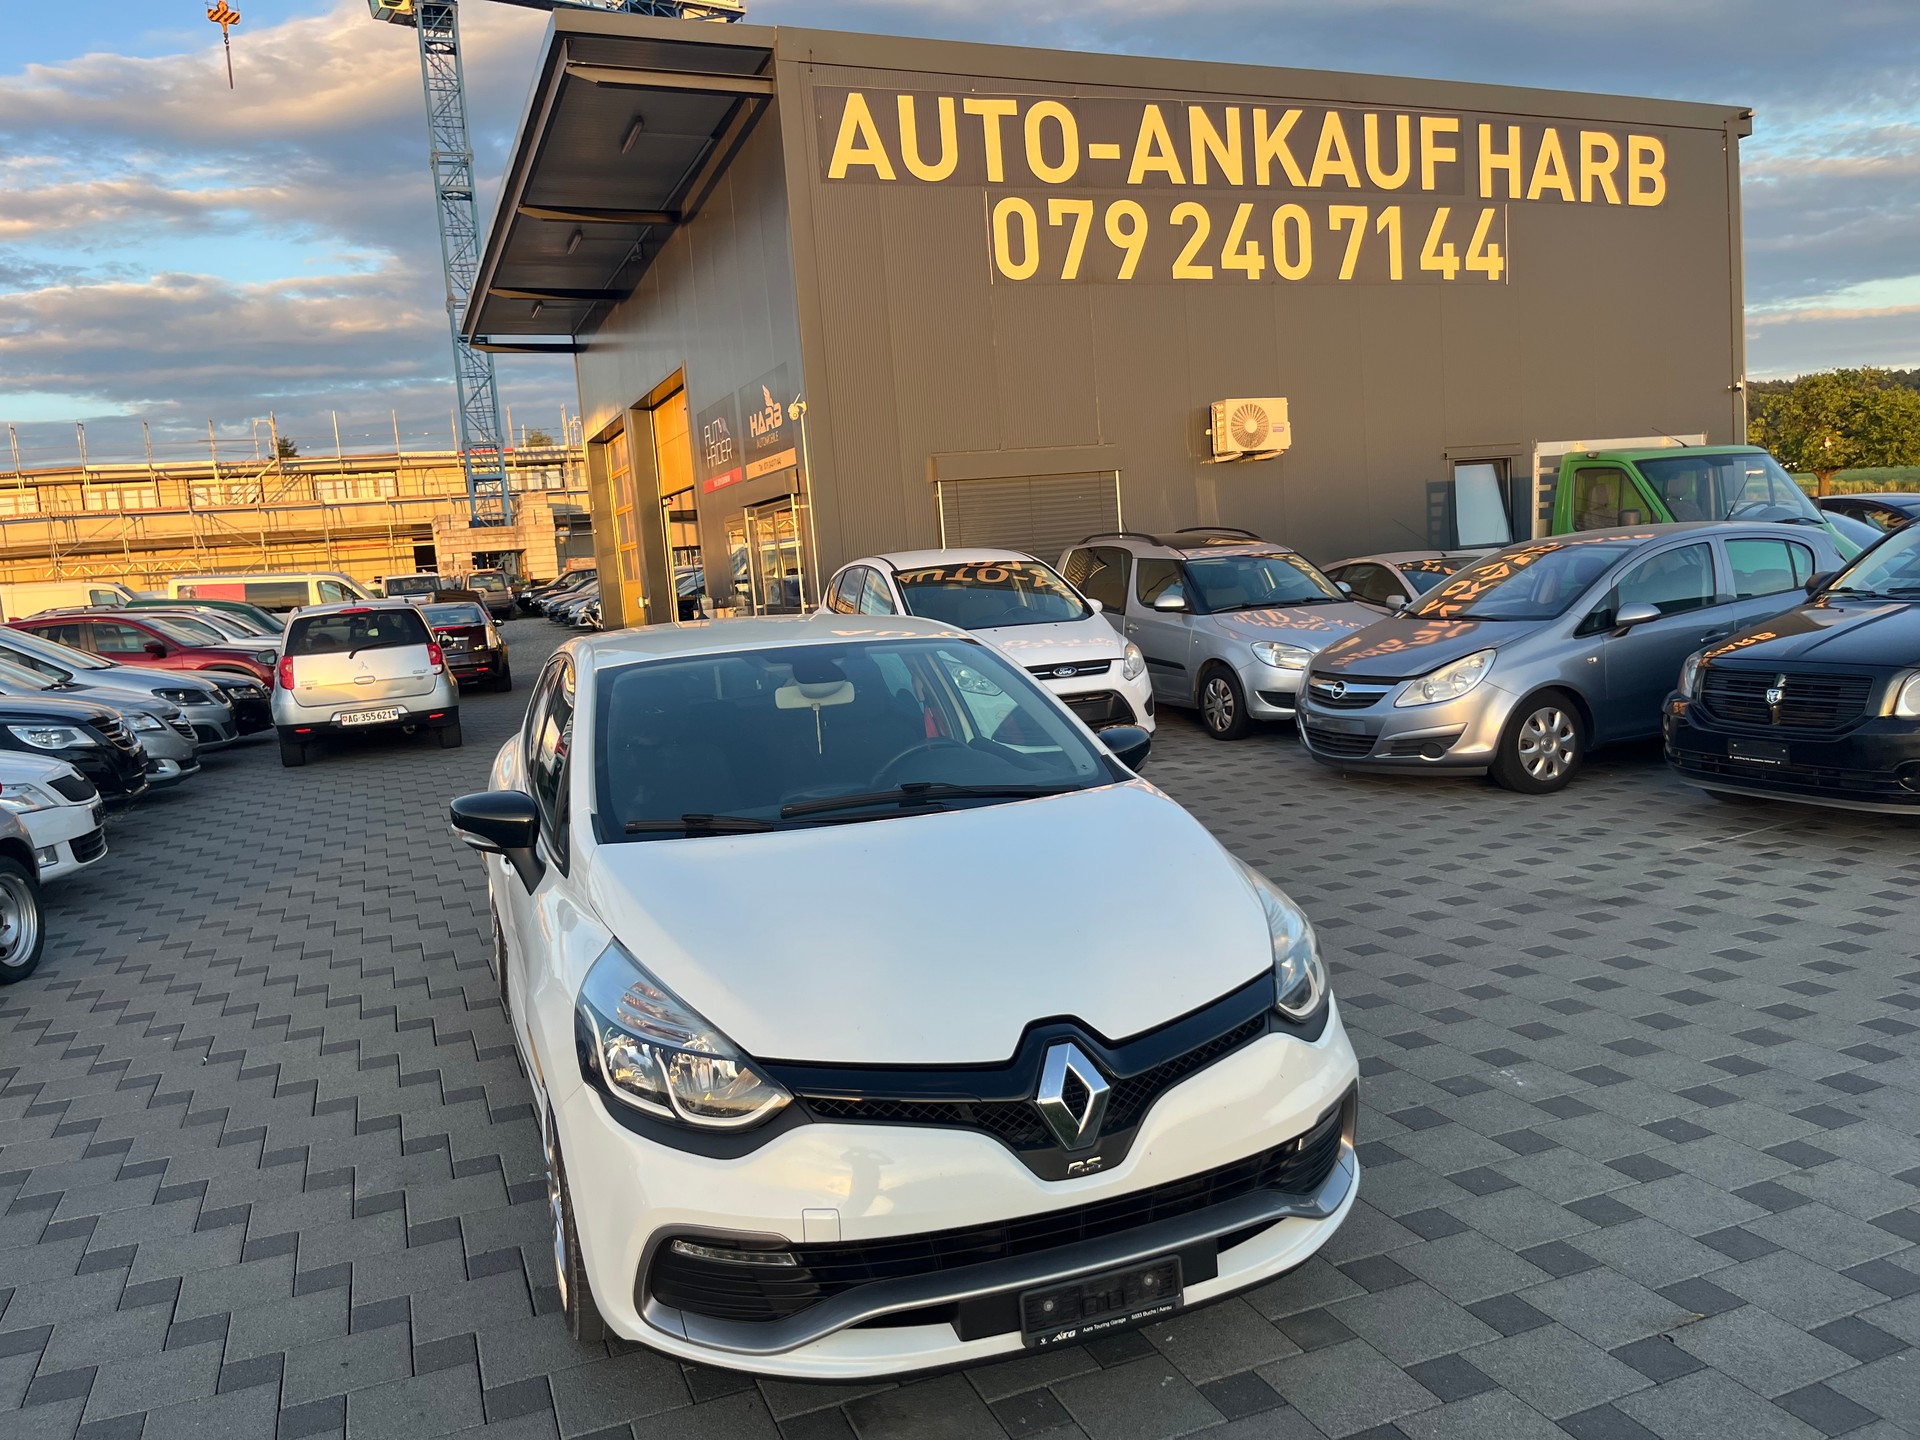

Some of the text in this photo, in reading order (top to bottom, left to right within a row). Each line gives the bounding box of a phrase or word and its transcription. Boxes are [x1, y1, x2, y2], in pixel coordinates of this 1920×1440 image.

[828, 92, 1666, 207] AUTO-ANKAUF HARB
[992, 196, 1504, 281] 079 240 71 44
[749, 402, 783, 438] HARB
